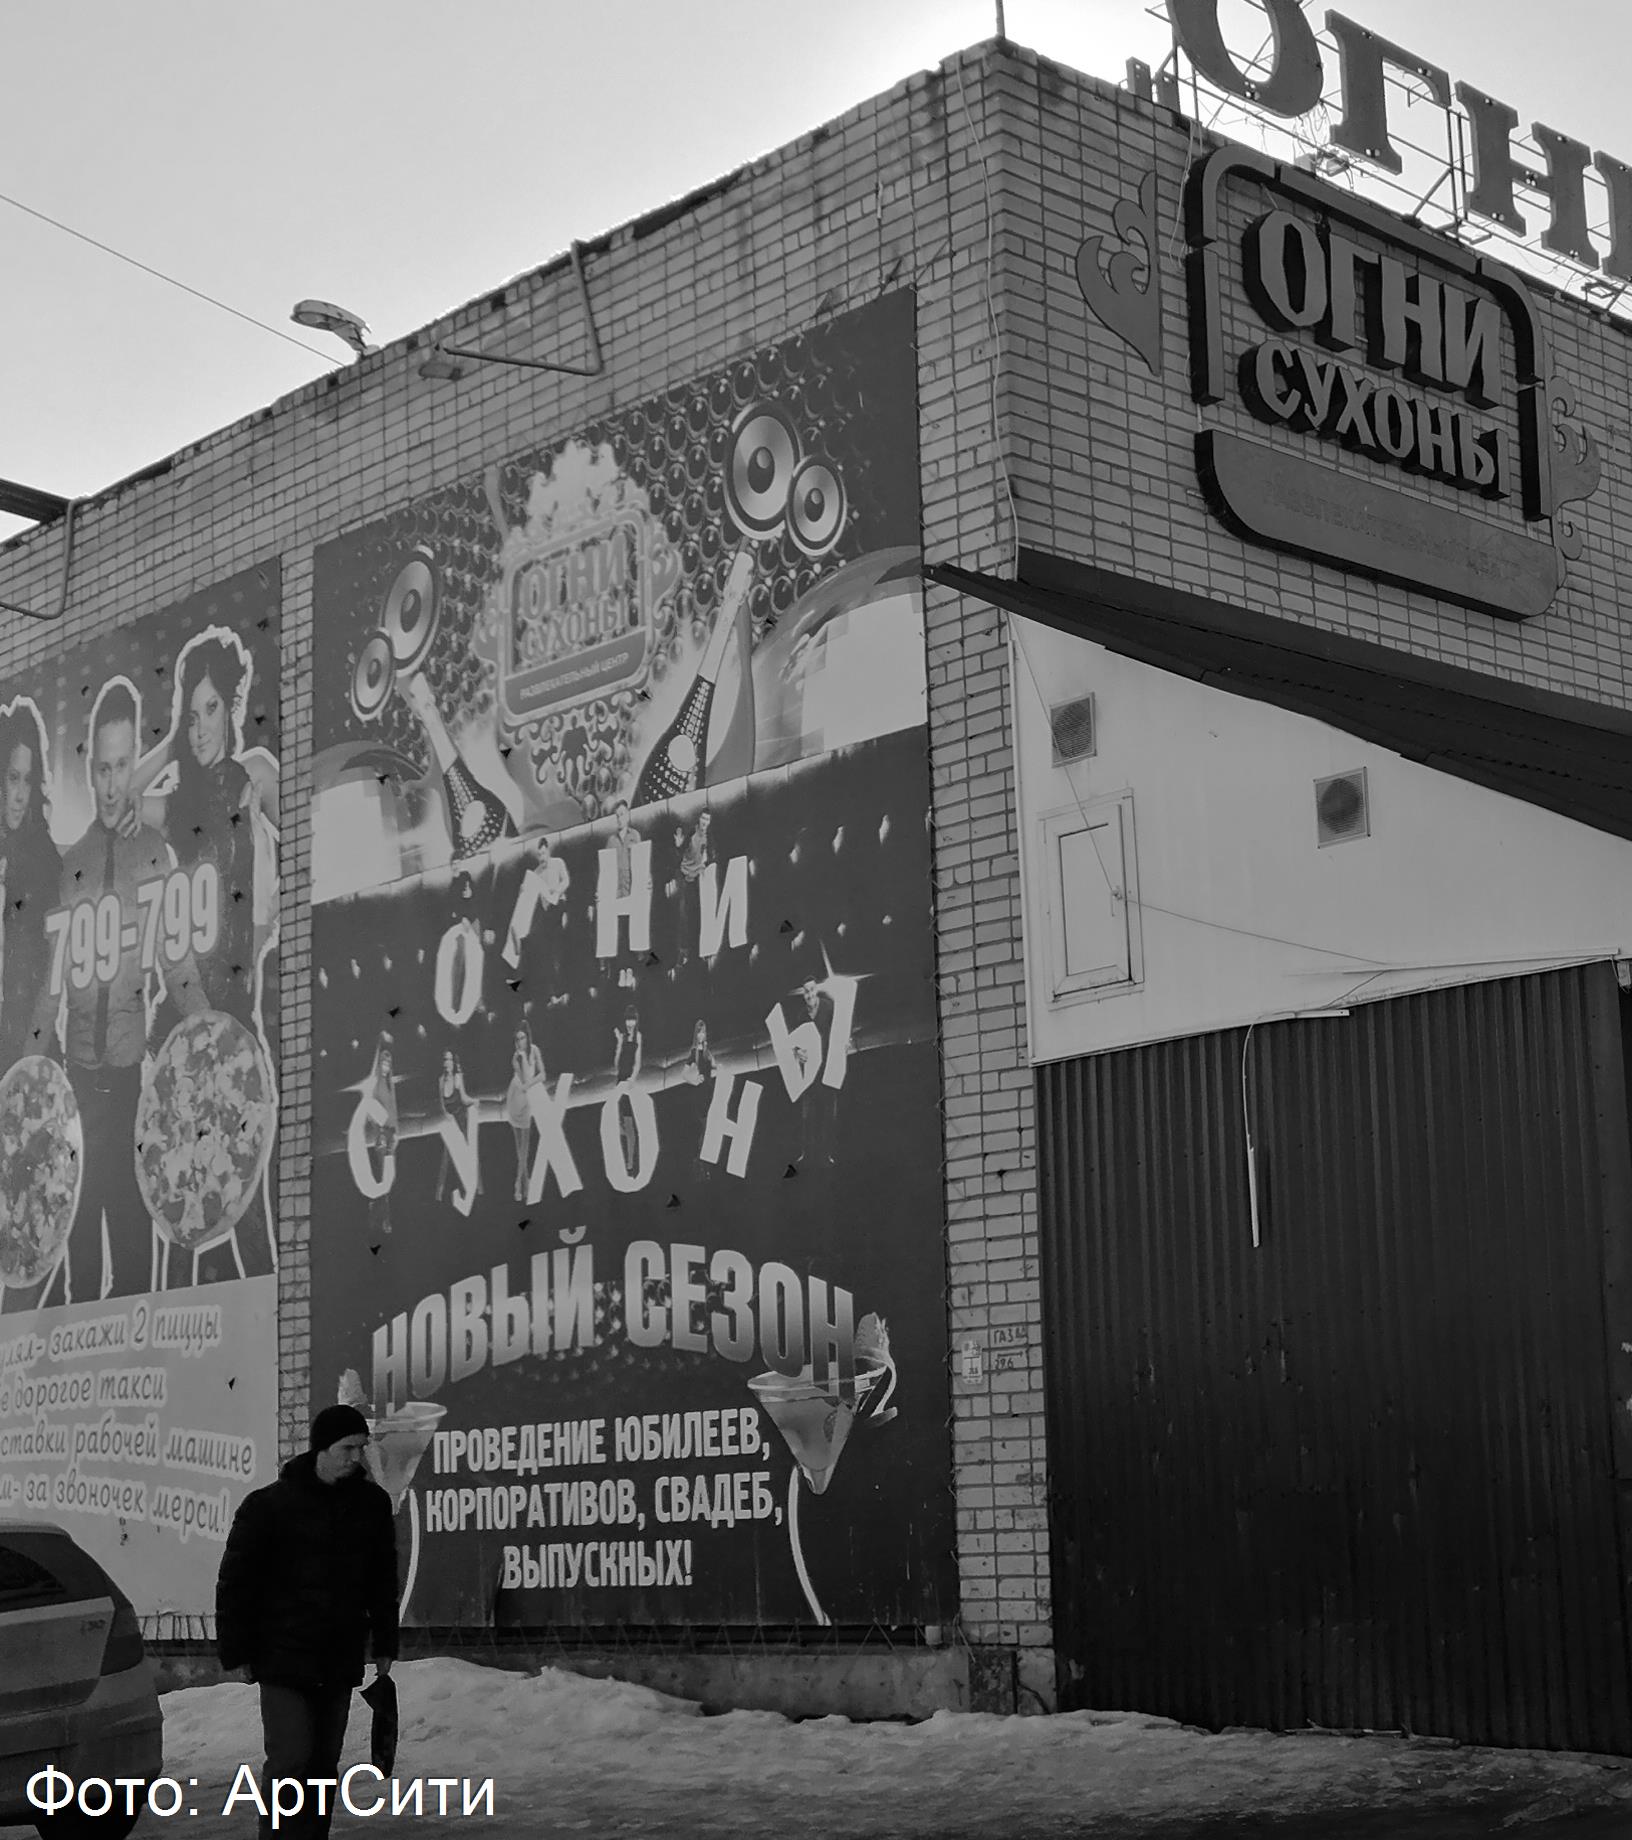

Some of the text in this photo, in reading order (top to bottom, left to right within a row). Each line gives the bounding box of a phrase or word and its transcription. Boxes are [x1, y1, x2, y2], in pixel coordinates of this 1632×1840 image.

[1246, 209, 1502, 410] ОГНИ
[1244, 338, 1511, 500] СУХОНЫ
[520, 532, 628, 620] ОГНИ
[520, 596, 627, 660] СУХОНЫ
[601, 652, 629, 671] ЦЕНТР
[46, 861, 219, 997] 799-799
[435, 840, 749, 1026] ОГНИ
[347, 974, 859, 1217] СУХОНЫ
[50, 1321, 125, 1357] закажи
[133, 1305, 147, 1345] 2
[155, 1308, 220, 1353] пиццы
[372, 1225, 856, 1420] НОВЫЙ СЕЗОН
[15, 1375, 92, 1416] дорогое
[99, 1372, 166, 1402] такси
[74, 1416, 157, 1463] рабочей
[165, 1431, 254, 1476] машине
[433, 1406, 771, 1477] ПРОВЕДЕНИЕ ЮБИЛЕЕВ,
[26, 1479, 47, 1502] за
[56, 1467, 144, 1515] звоночек
[152, 1490, 228, 1537] мерси!
[425, 1471, 783, 1532] КОРПОРАТИВОВ, СВАДЕБ,
[502, 1539, 694, 1590] ВЫПУСКНЫХ!
